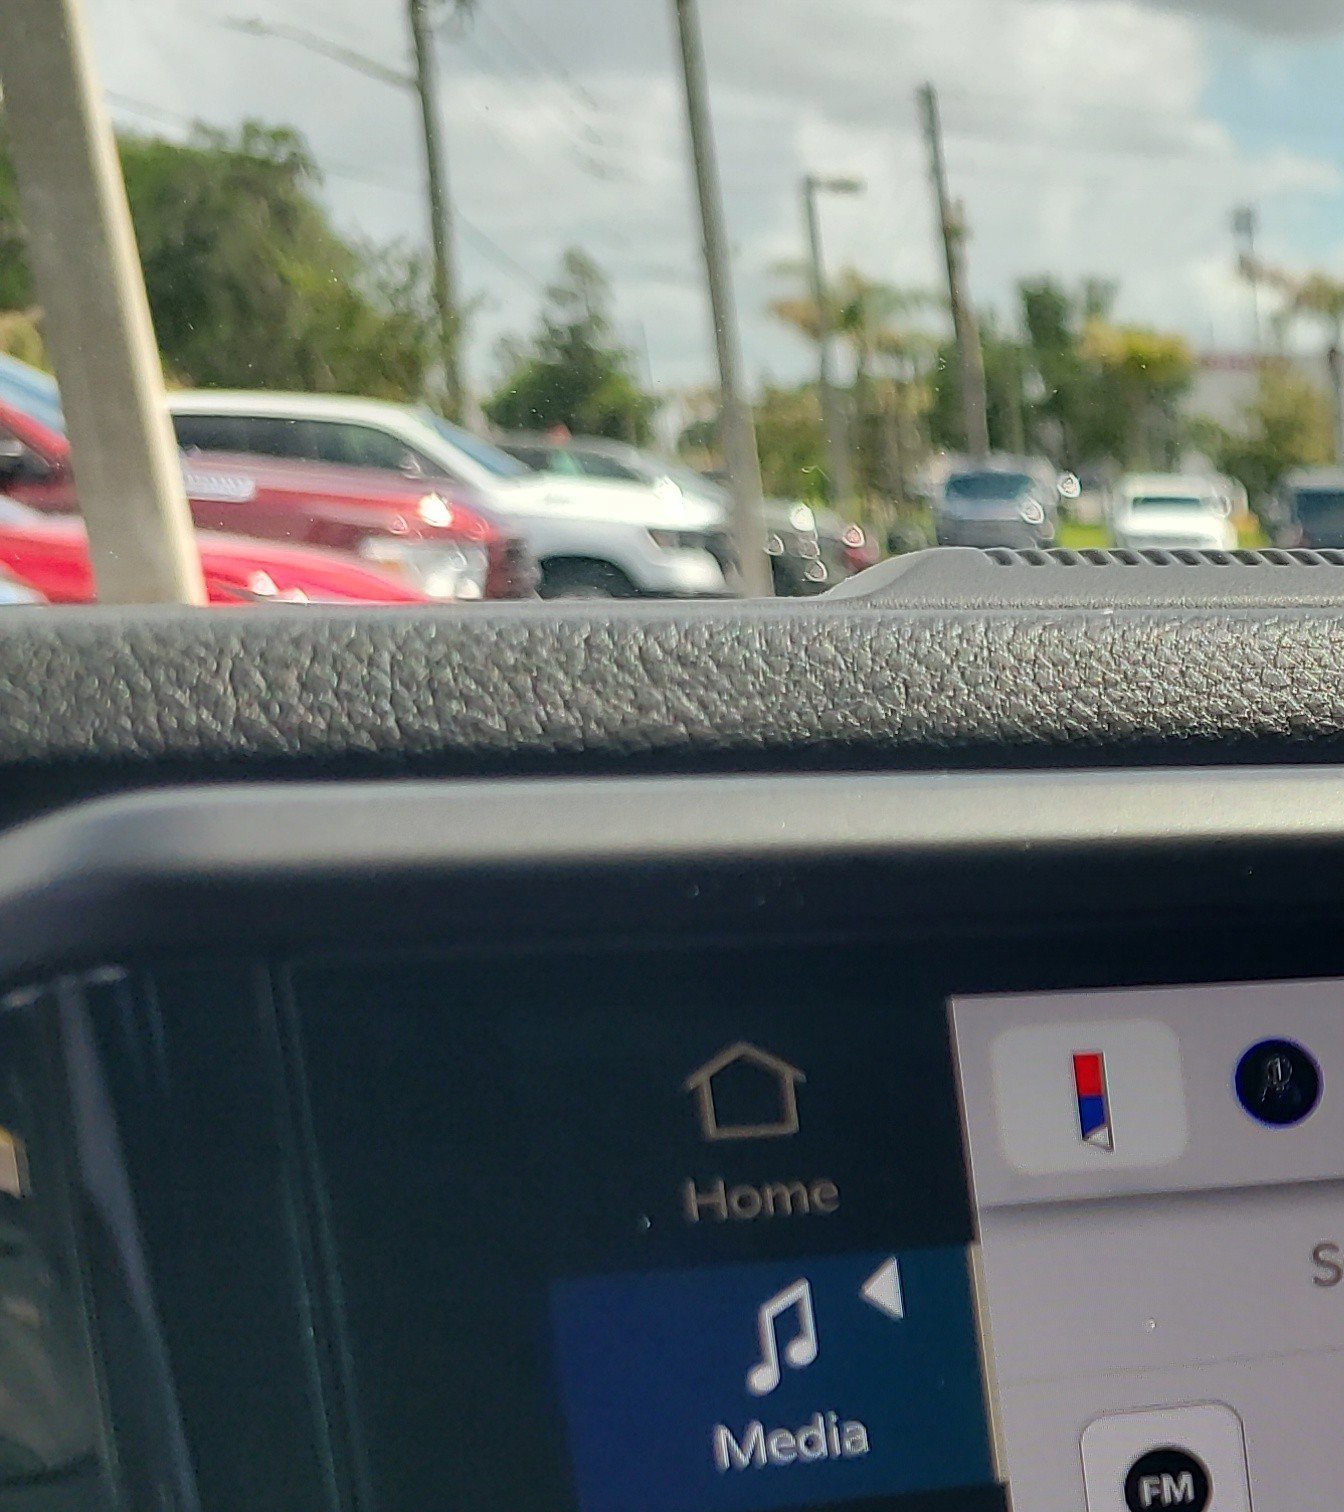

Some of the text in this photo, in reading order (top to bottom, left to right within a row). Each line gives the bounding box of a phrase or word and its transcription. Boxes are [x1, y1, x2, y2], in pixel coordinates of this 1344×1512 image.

[684, 1176, 841, 1222] Home
[712, 1411, 870, 1471] Media
[1137, 1471, 1195, 1508] FM
